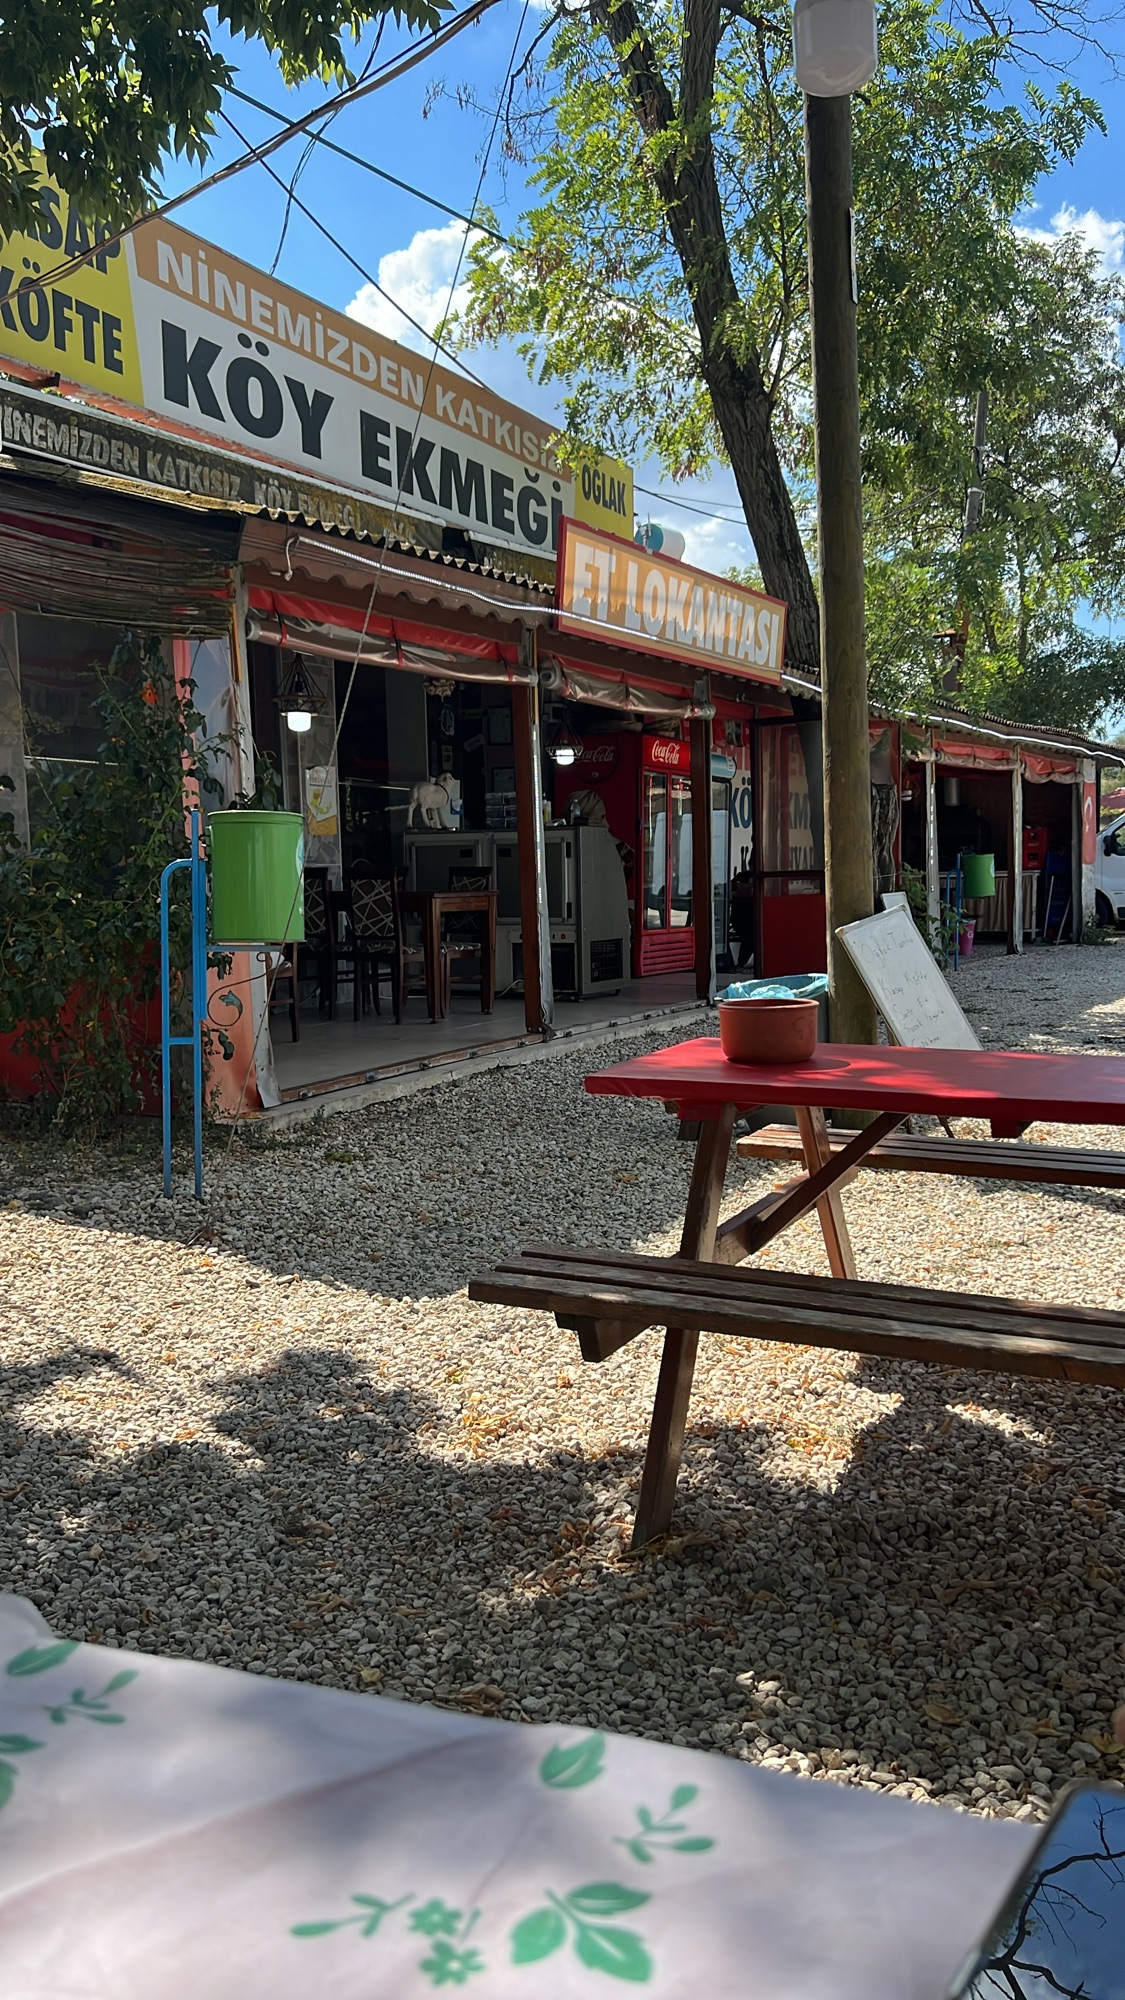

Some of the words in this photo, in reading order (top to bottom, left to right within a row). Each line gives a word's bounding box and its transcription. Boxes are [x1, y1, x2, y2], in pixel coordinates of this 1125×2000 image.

[157, 239, 424, 404] NİNEMİZDEN
[161, 319, 335, 460] KÖY
[359, 409, 563, 550] EKMEĞİ
[581, 457, 627, 518] OĞLAK
[572, 541, 617, 621] ET
[624, 560, 780, 668] LOKANTASI
